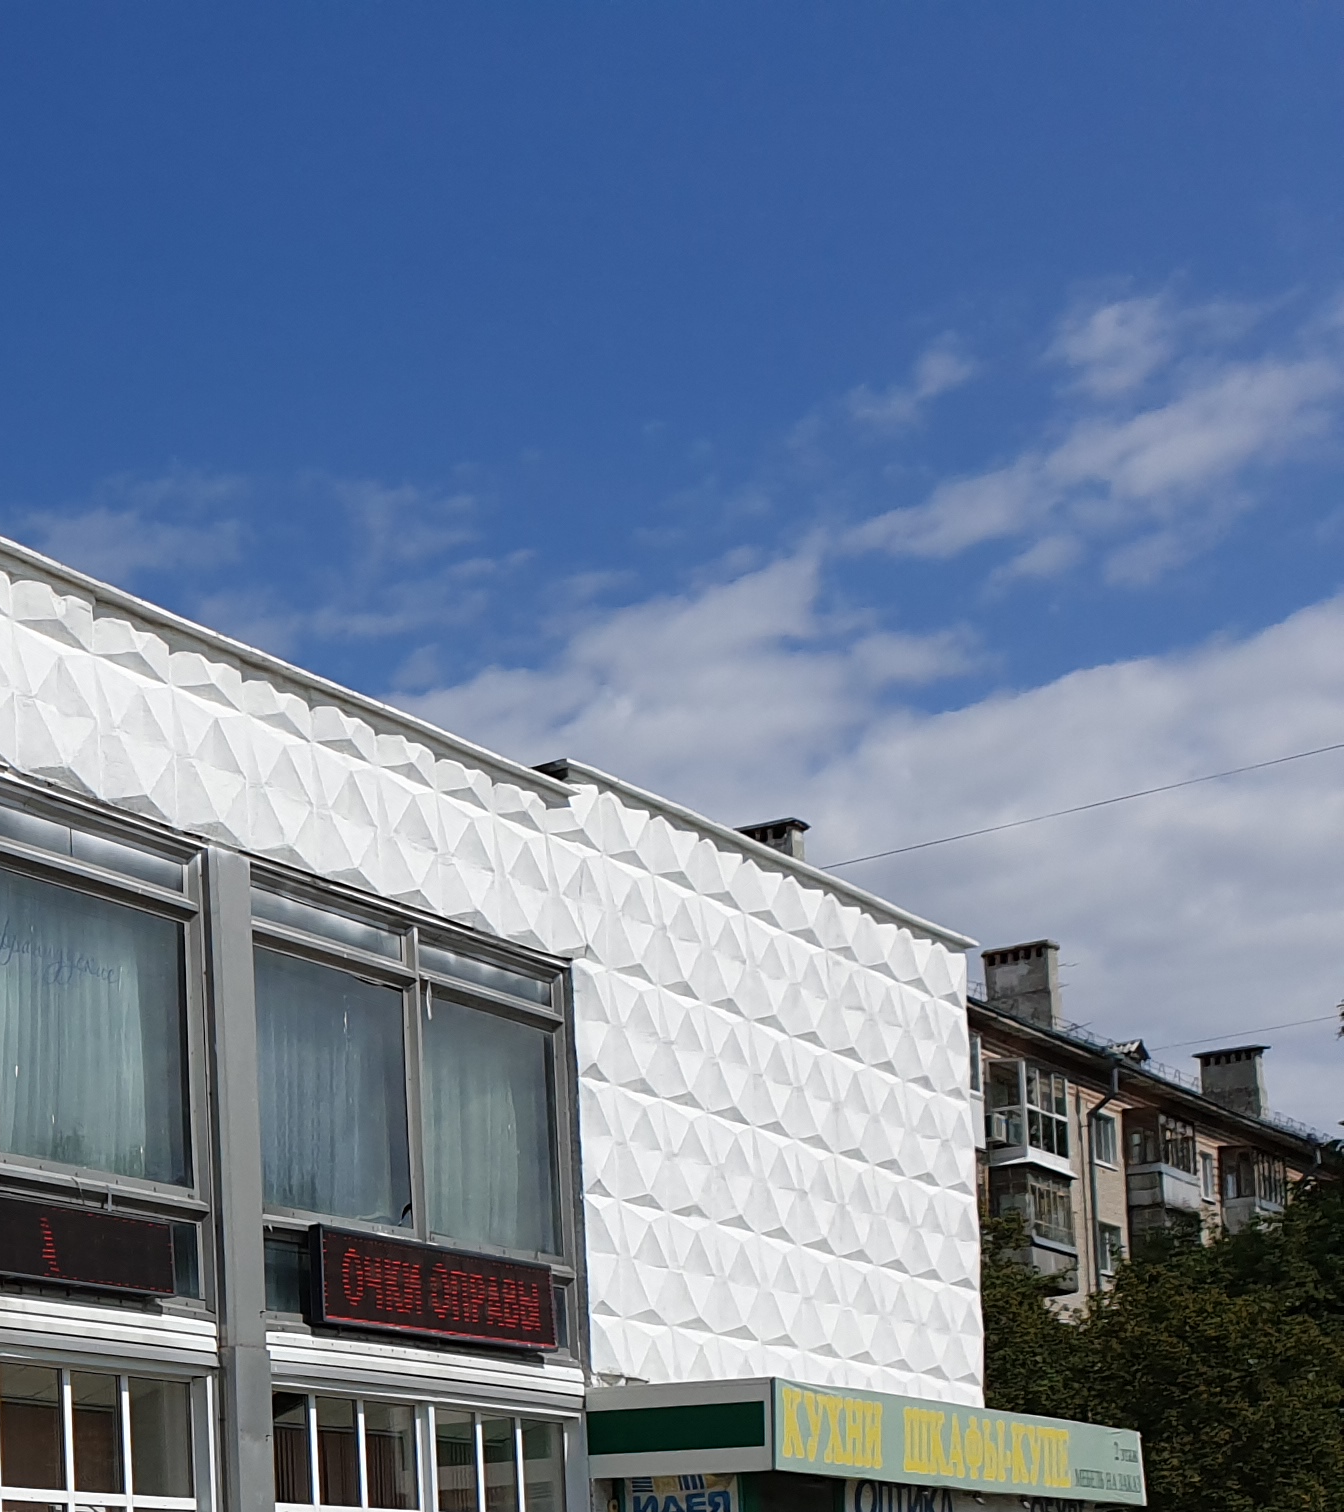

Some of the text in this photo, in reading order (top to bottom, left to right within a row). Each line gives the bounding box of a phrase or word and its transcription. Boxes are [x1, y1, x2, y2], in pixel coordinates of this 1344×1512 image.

[342, 1247, 541, 1331] ОЧКИ ОПРАВЫ
[782, 1387, 1071, 1488] КУХНИ ШКАФЫ-КУПЕ
